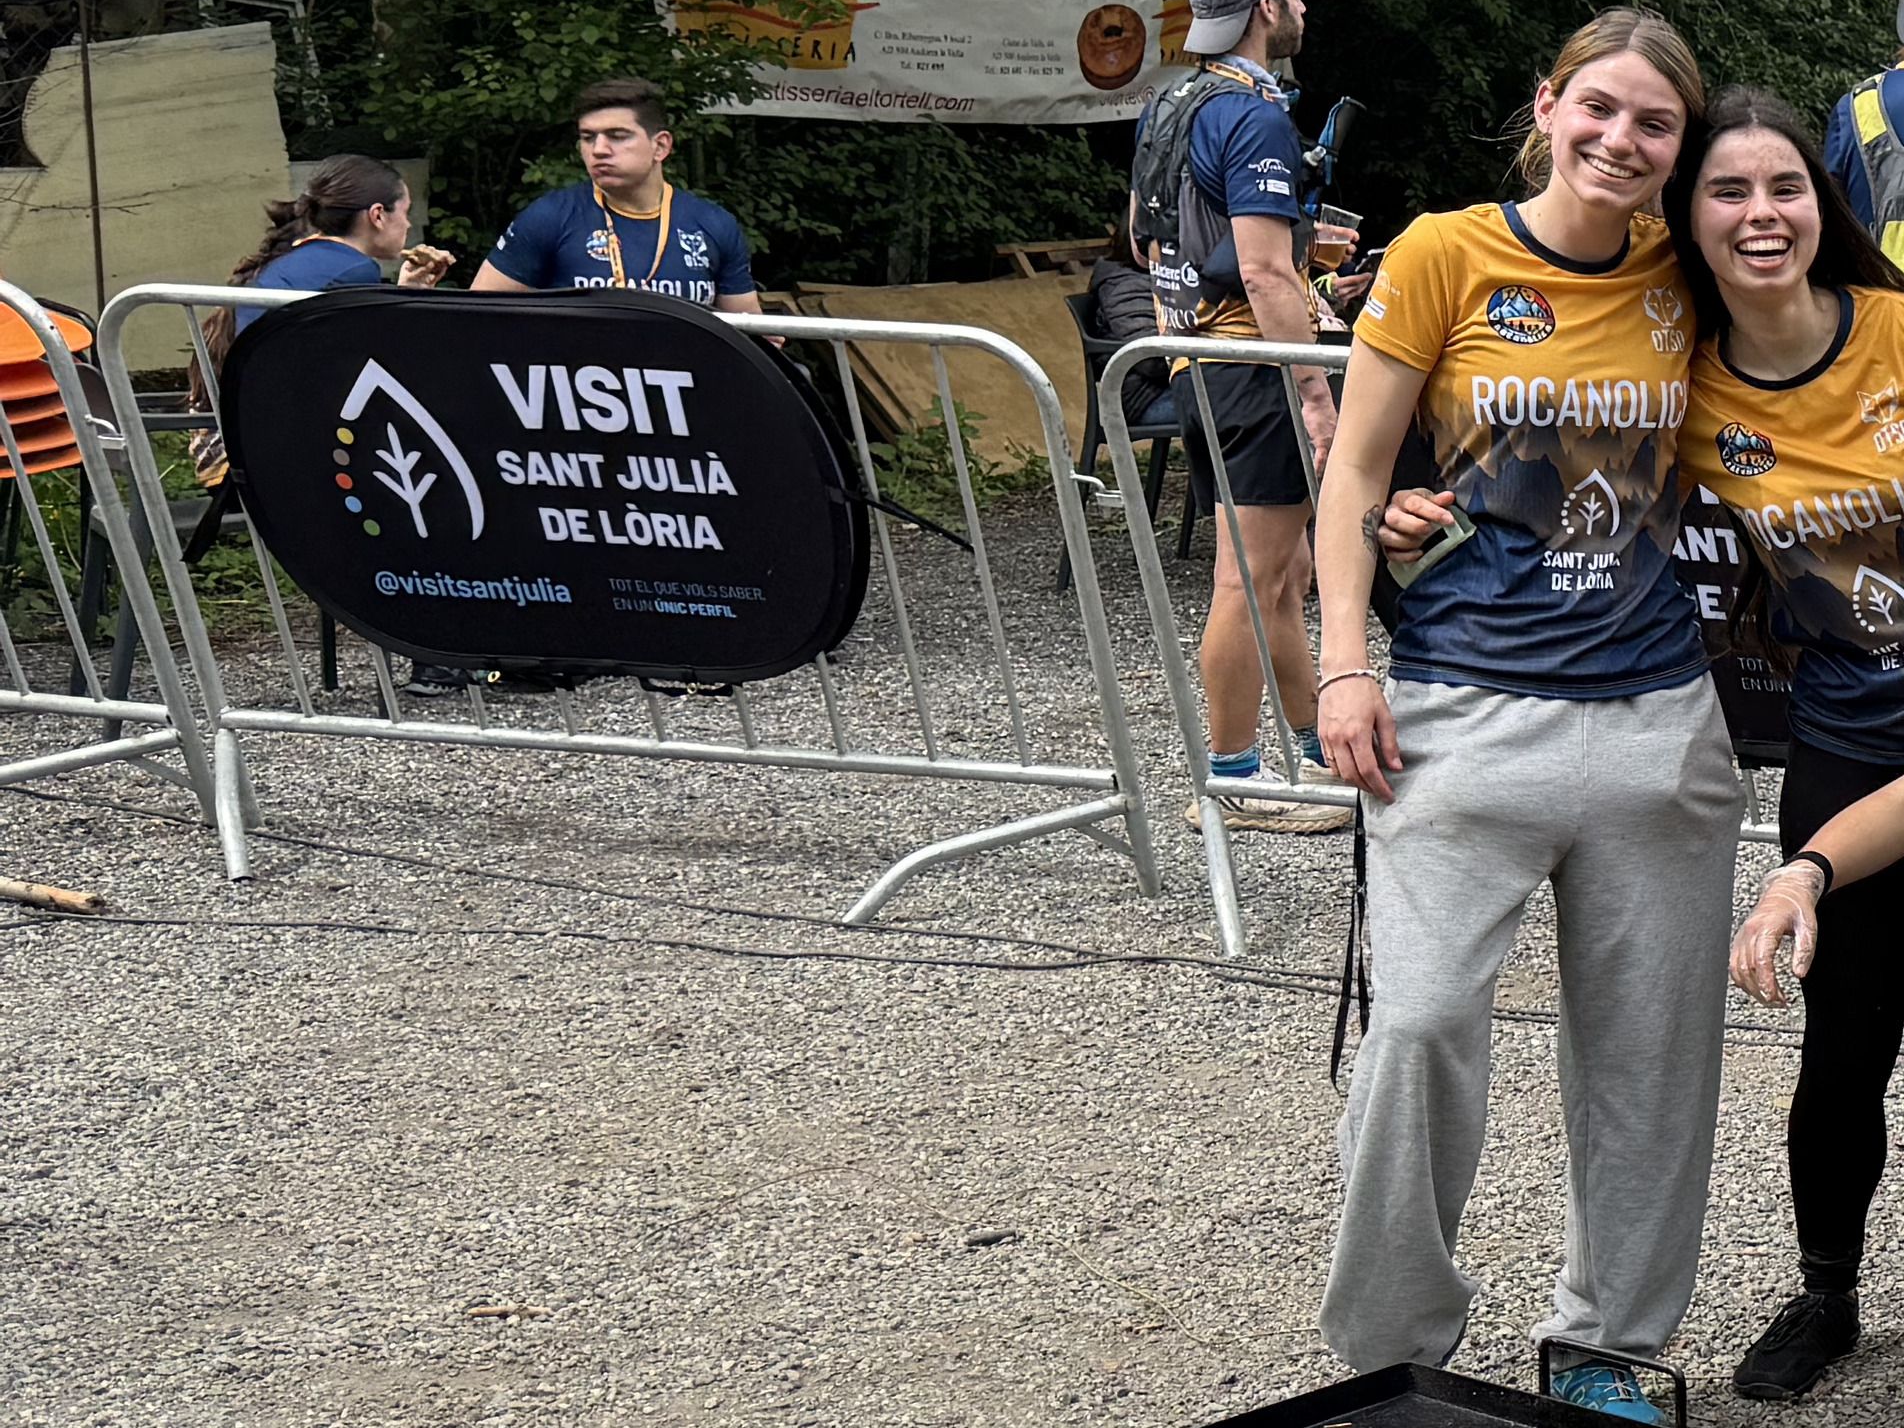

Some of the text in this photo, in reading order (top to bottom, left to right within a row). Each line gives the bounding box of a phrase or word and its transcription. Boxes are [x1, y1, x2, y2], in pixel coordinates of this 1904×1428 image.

[1651, 330, 1686, 353] OTSO
[490, 363, 694, 436] VISIT
[1471, 375, 1688, 429] ROCANOLIC
[496, 450, 738, 496] SANT JULIÀ
[538, 502, 724, 551] DE LÒRIA
[1672, 525, 1739, 564] ANT
[1542, 550, 1584, 570] SANT
[375, 570, 573, 608] @visitsantjulia
[1551, 572, 1573, 591] DE
[654, 597, 687, 615] ÚNIC
[689, 601, 737, 619] PERFIL
[1696, 584, 1727, 621] E
[1881, 653, 1900, 671] DE
[1742, 677, 1762, 691] EN
